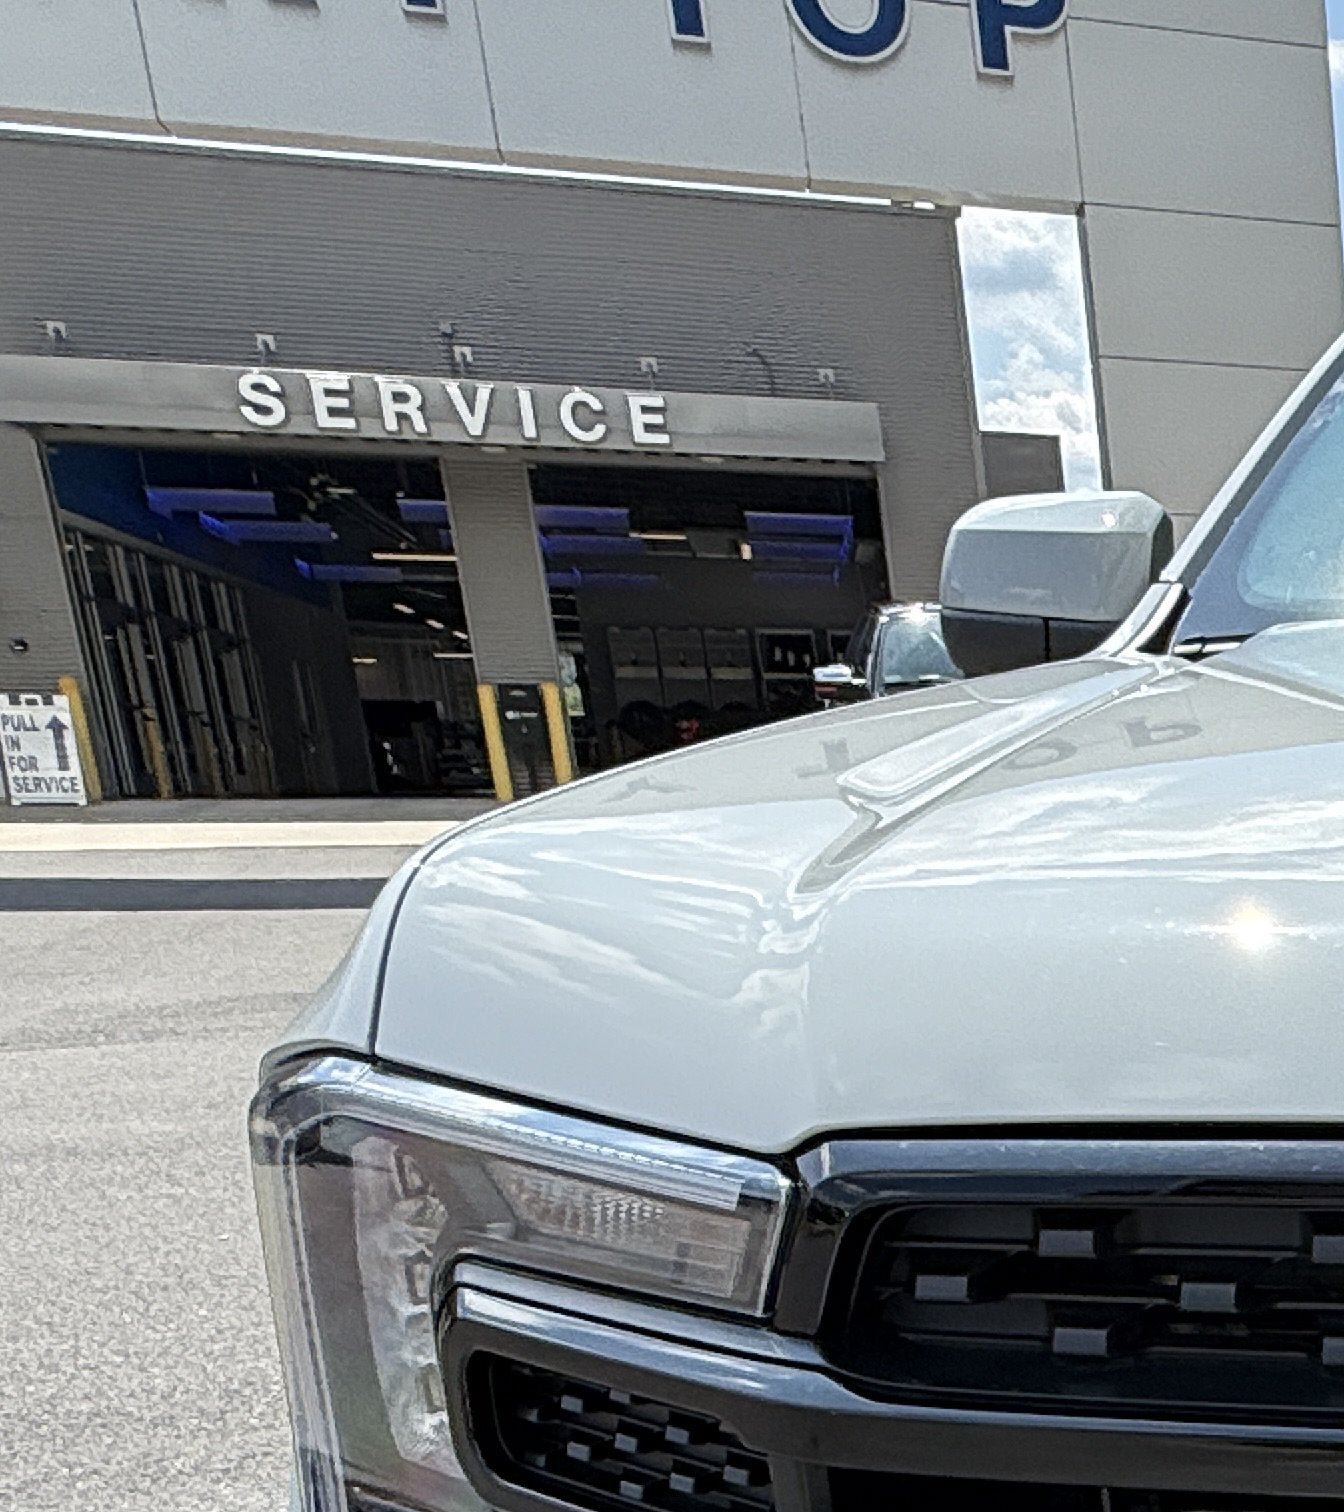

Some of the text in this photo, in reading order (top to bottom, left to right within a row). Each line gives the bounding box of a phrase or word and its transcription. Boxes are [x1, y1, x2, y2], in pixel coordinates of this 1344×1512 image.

[237, 371, 671, 445] SERVICE
[1, 713, 40, 731] PULL
[6, 735, 20, 751] IN
[9, 755, 39, 772] FOR
[12, 776, 79, 793] SERVICE
